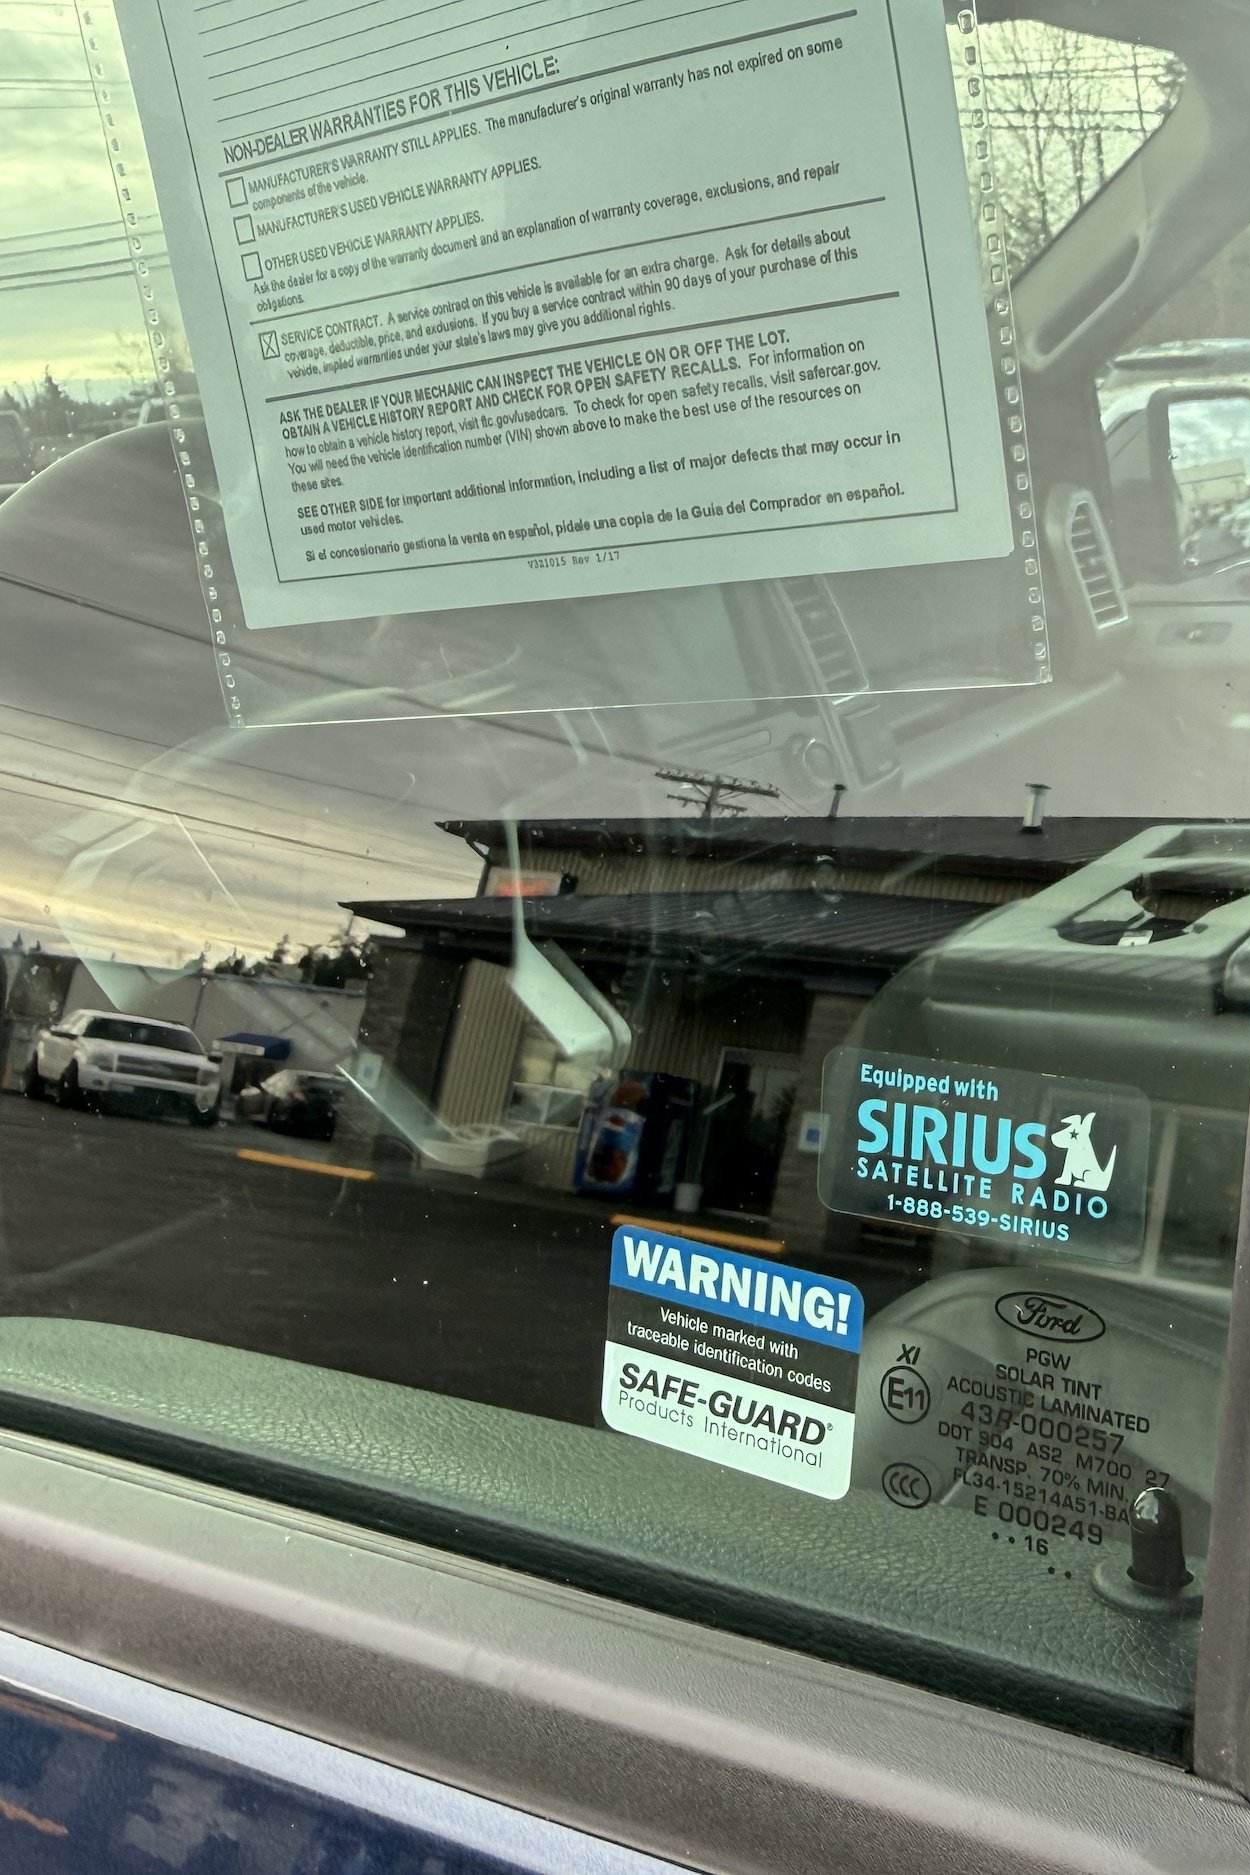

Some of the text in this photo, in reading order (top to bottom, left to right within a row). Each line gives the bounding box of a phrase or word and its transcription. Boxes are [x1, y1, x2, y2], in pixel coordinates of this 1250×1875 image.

[223, 55, 561, 165] NON-DEALER WARRANTIES FOR THIS VEHICLE:
[247, 37, 844, 195] MANUFACTURER'S WARRANTY STILL APPLIES. The manufacturer's original warranty has not expired on some
[251, 171, 369, 212] components of the vehicle.
[347, 195, 379, 215] USED
[378, 183, 426, 208] VEHICLE
[424, 167, 488, 197] WARRANTY
[490, 155, 542, 181] APPLIES.
[263, 209, 485, 272] OTHER USED VEHICLE WARRANTY APPLIES.
[279, 328, 790, 426] ASK THE DEALER IF YOUR MECHANIC CAN INSPECT THE VEHICLE ON OR OFF THE LOT.
[281, 339, 866, 441] OBTAIN A VEHICLE HISTORY REPORT AND CHECK FOR OPEN SAFETY RECALLS. For information on
[296, 429, 902, 520] SEE OTHER SIDE for important additional information, including a list of major defects that may occur in
[299, 512, 404, 536] used motor vehicles.
[305, 549, 316, 563] Si
[317, 547, 328, 561] el
[329, 539, 401, 560] concesionario
[402, 536, 448, 555] gestiona
[447, 533, 460, 547] la
[459, 531, 491, 545] venta
[491, 530, 507, 542] en
[507, 521, 554, 542] español,
[592, 517, 619, 531] una
[618, 510, 655, 529] copia
[656, 508, 674, 523] de
[675, 506, 690, 521] la
[725, 499, 747, 515] del
[749, 491, 822, 513] Comprador
[825, 491, 844, 504] en
[845, 481, 905, 504] español.
[571, 555, 591, 566] Rev
[595, 550, 620, 563] 1/17
[861, 1064, 998, 1101] Equipped with
[857, 1099, 1047, 1179] SIRIUS
[856, 1157, 1108, 1219] SATELLITE RADIO
[887, 1194, 1069, 1242] 1-888-539-SIRIUS
[624, 1236, 851, 1335] WARNING!
[660, 1307, 798, 1359] Vehicle marked with
[1015, 1297, 1083, 1335] Ford
[627, 1322, 831, 1392] traceable identification codes
[897, 1344, 920, 1365] XI
[996, 1364, 1102, 1400] SOLAR TINT
[1026, 1348, 1071, 1371] PGW
[887, 1377, 925, 1411] E11
[947, 1377, 1150, 1433] ACOUSTIC LAMINATED
[619, 1390, 822, 1468] Products International
[938, 1421, 973, 1442] DOT
[979, 1430, 1013, 1451] 904
[1027, 1442, 1062, 1464] AS2
[1076, 1451, 1131, 1480] M700
[955, 1447, 1129, 1503] TRANSP. 70% MIN.
[975, 1495, 1103, 1546] E 000249
